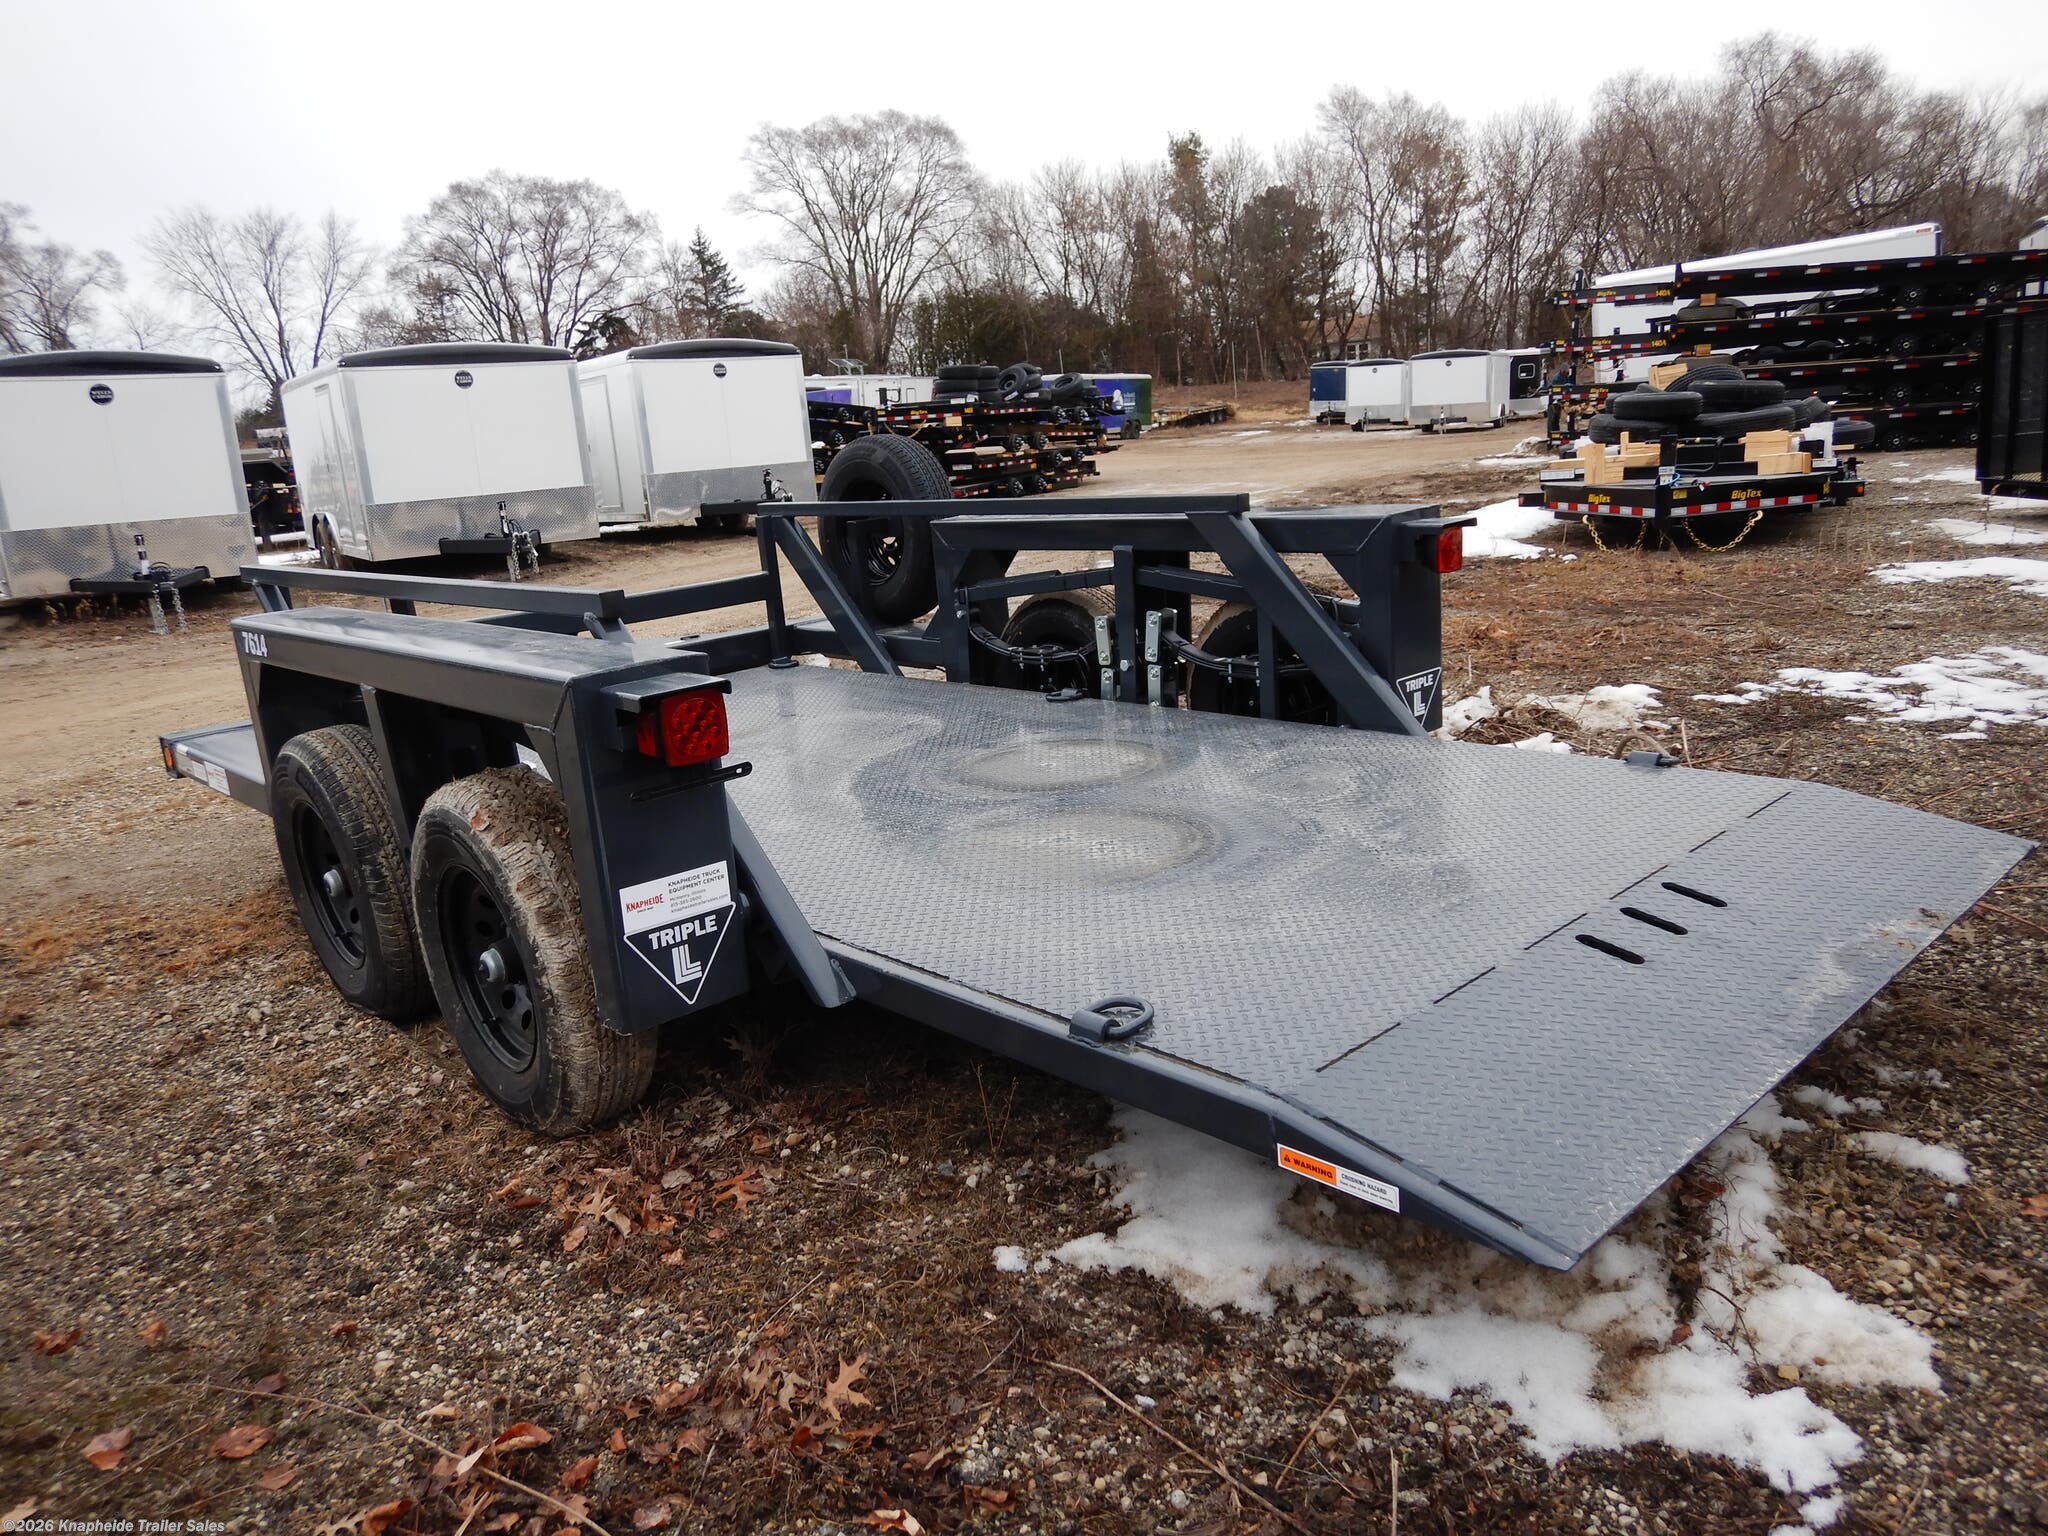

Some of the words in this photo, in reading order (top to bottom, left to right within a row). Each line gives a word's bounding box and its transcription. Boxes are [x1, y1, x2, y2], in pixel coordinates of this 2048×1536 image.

[1588, 493, 1611, 504] BigTex
[1731, 489, 1763, 501] BigTex
[241, 631, 268, 657] 7614
[1405, 674, 1434, 693] TRIPLE
[668, 874, 701, 887] KNAPHEIDE
[702, 869, 721, 879] TRUCK
[668, 880, 706, 894] EQUIPMENT
[703, 874, 725, 885] CENTER
[625, 893, 664, 913] KNAPHEIDE
[648, 914, 718, 950] TRIPLE
[1293, 1157, 1334, 1179] WARNING
